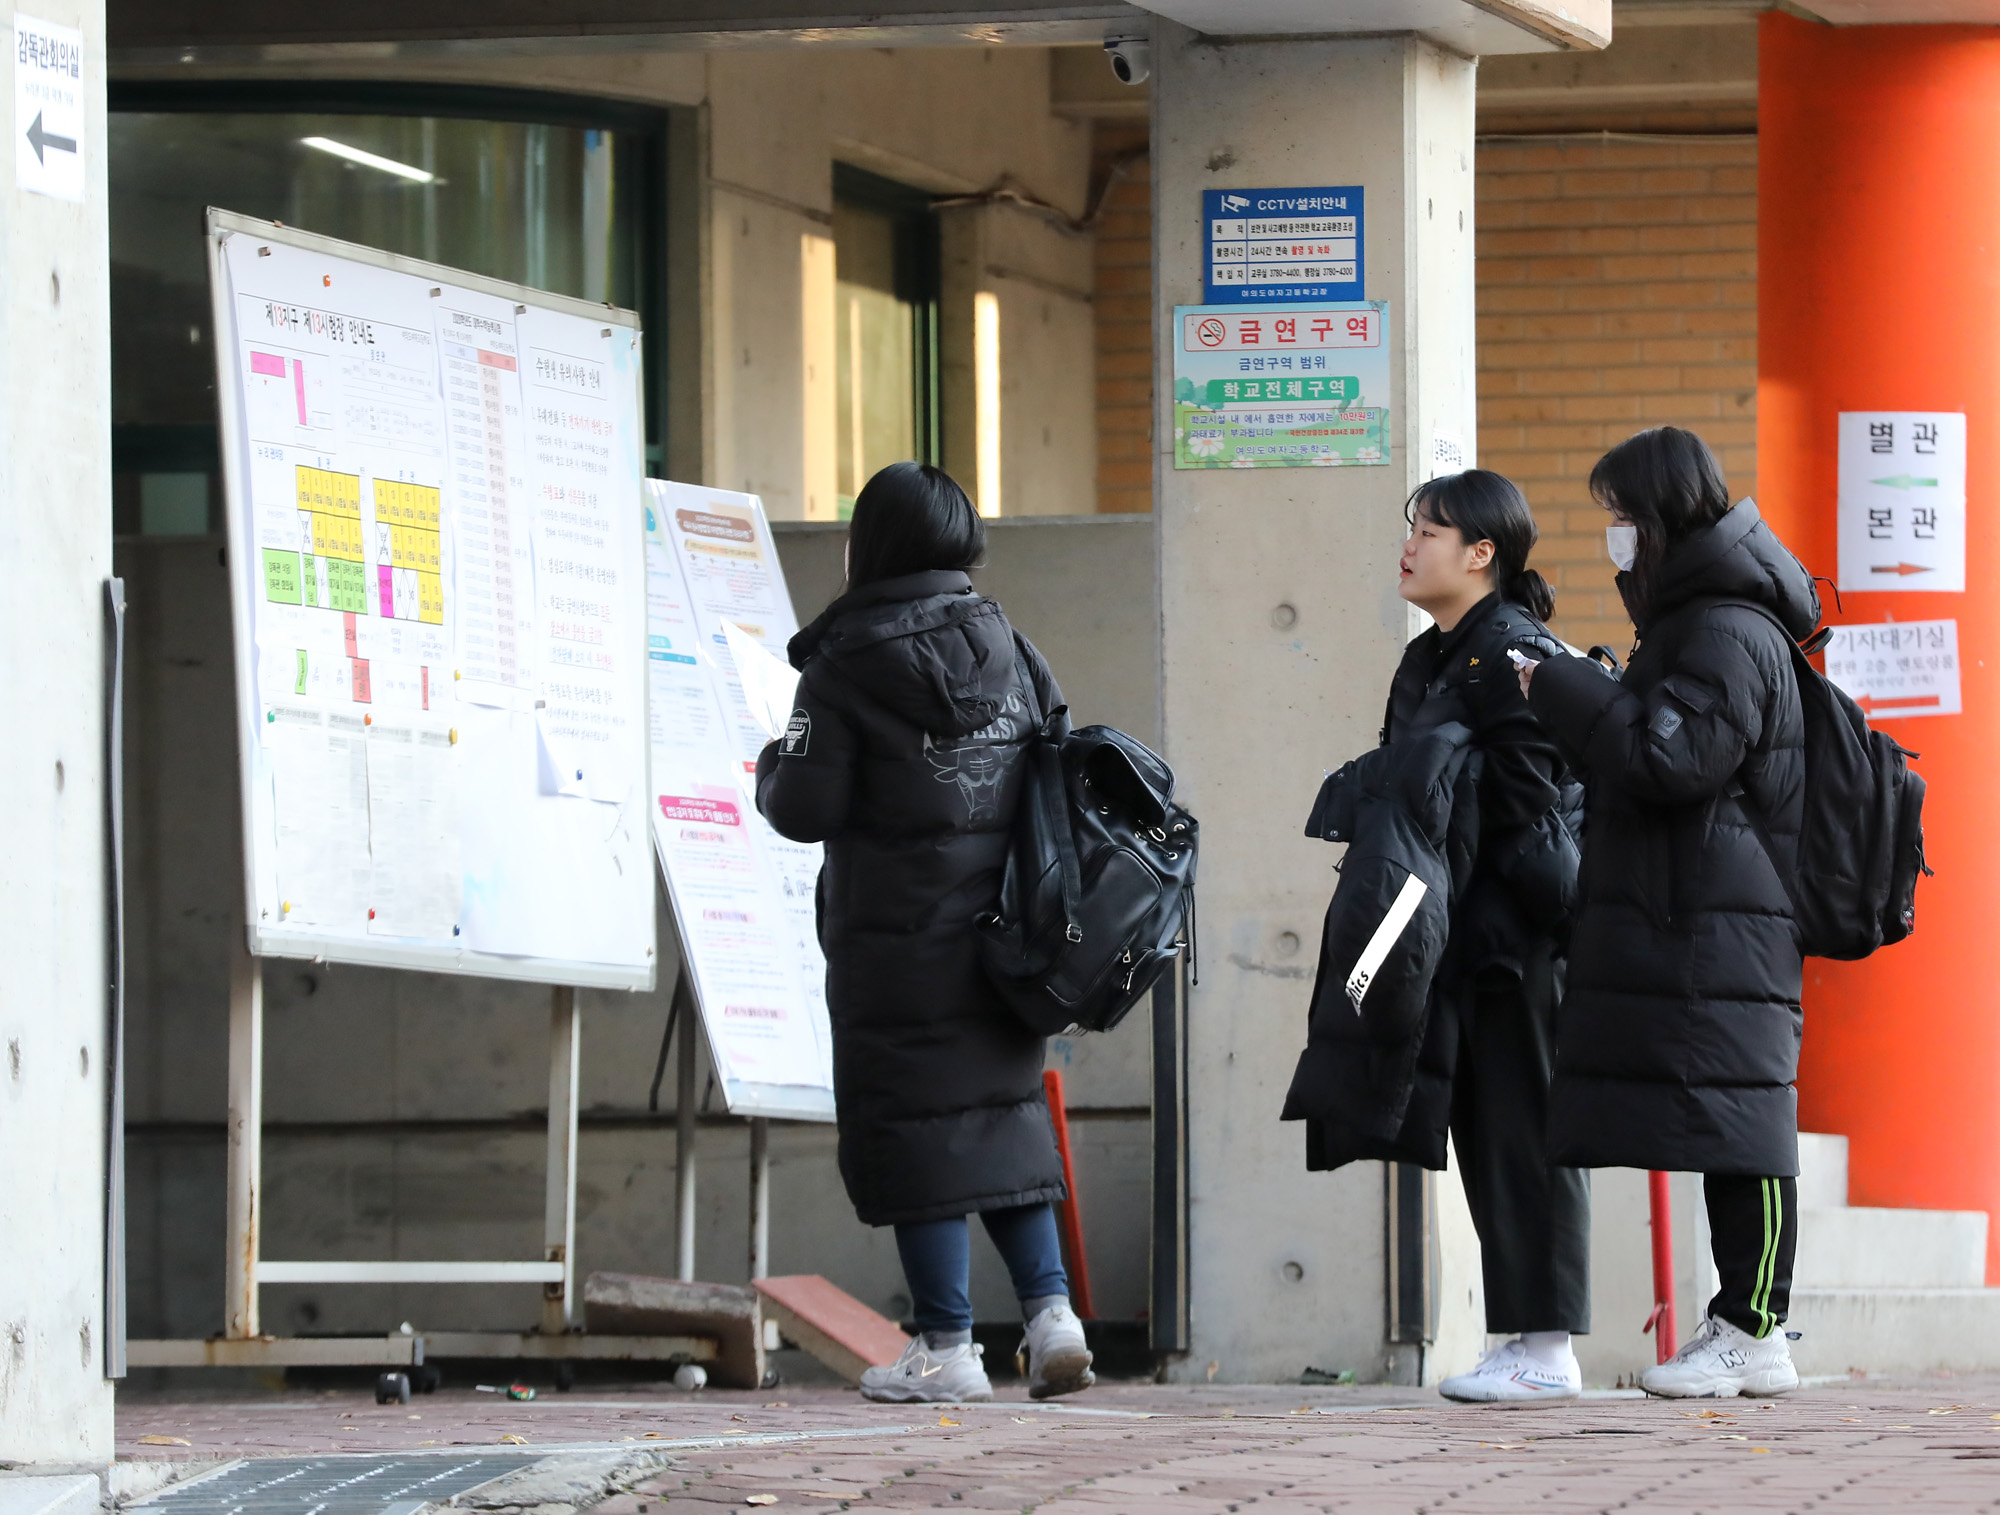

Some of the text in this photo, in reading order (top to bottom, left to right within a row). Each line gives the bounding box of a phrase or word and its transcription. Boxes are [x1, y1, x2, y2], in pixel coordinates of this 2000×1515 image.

[18, 29, 79, 80] 감독관회의실
[1257, 196, 1347, 211] CCTV설치안내
[1216, 247, 1243, 257] 촬영시간
[1251, 246, 1272, 256] 24시간
[1275, 246, 1288, 255] 연속
[1291, 246, 1304, 256] 촬영
[1307, 245, 1313, 255] 및
[1251, 269, 1267, 279] 교무실
[1304, 267, 1320, 278] 행정실
[1322, 267, 1353, 277] 3780-4300
[1241, 288, 1328, 298] 여의도여자고등학교장
[265, 302, 376, 346] 제13지구 제13시험장 안내도
[1239, 316, 1368, 345] 금연구역
[1239, 355, 1326, 371] 금연구역 범위
[1223, 379, 1346, 400] 학교전체구역
[1191, 411, 1375, 425] 학교시설 내 에서 흡연한 자에게는 10만원의
[1191, 428, 1226, 438] 과태료가
[1231, 427, 1274, 438] 부과됩니다
[1869, 422, 1939, 454] 별관
[1235, 445, 1331, 456] 여의도여자고등학교
[1867, 507, 1938, 539] 본관
[1836, 624, 1944, 653] 기자대기실
